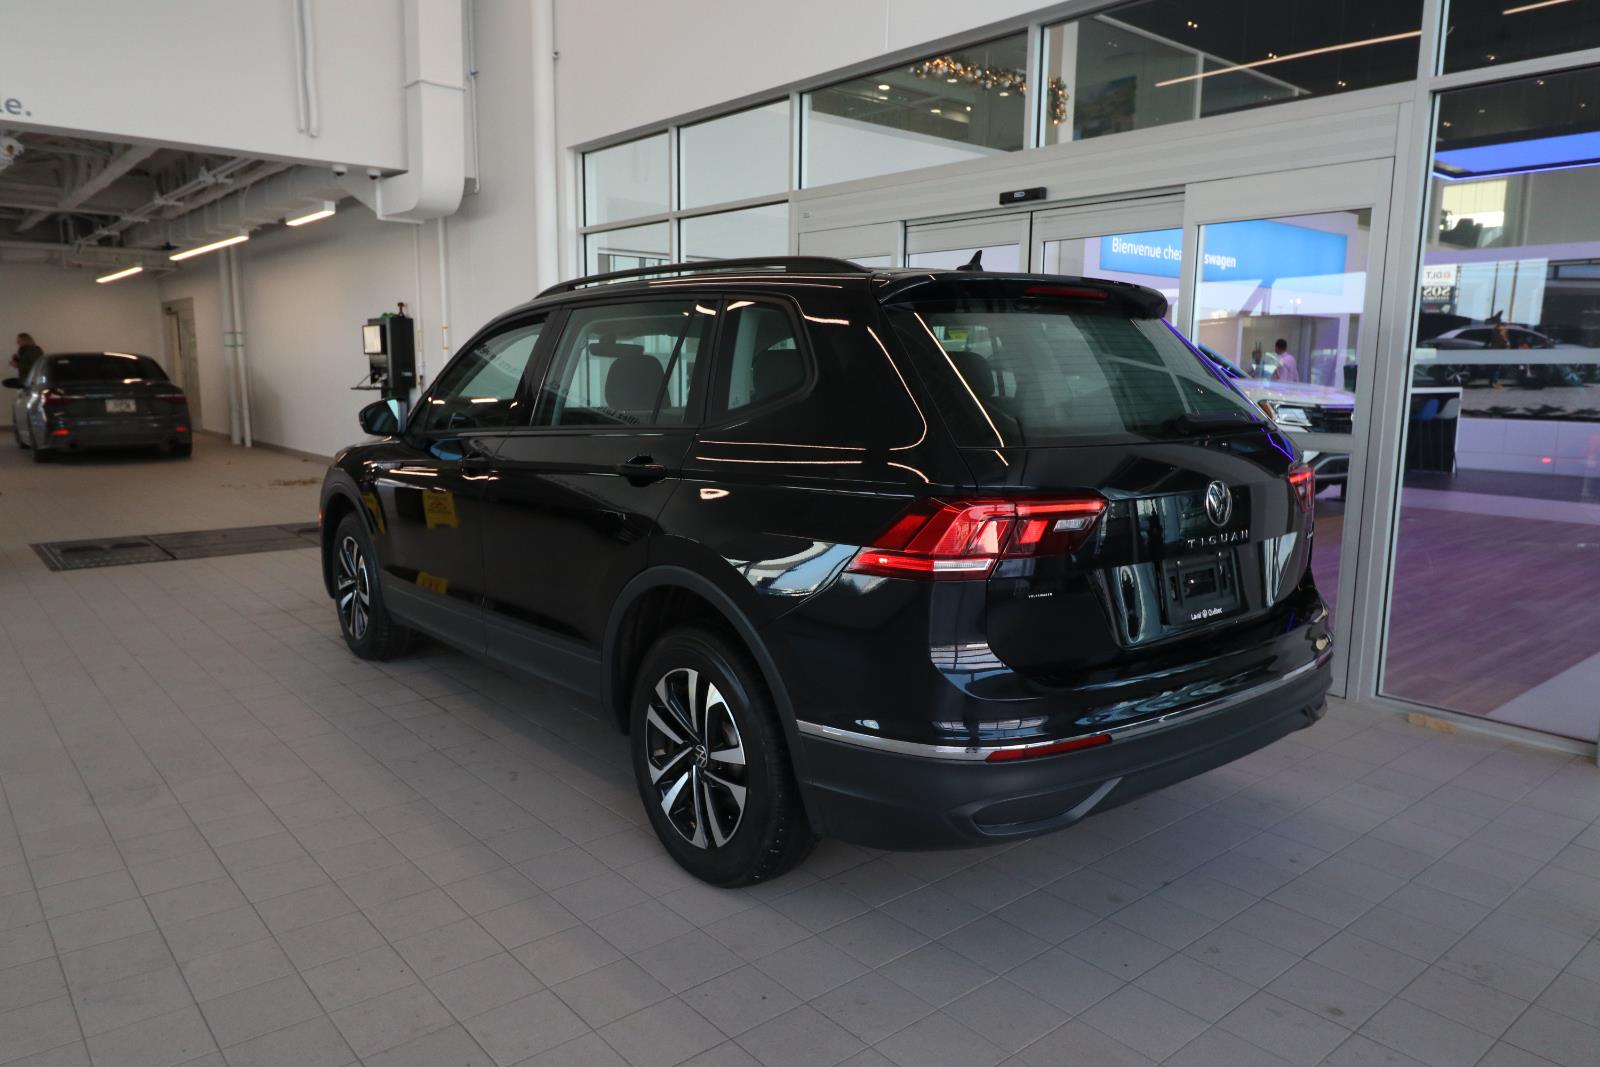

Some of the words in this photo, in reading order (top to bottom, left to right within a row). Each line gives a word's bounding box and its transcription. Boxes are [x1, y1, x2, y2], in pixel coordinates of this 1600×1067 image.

[1112, 237, 1161, 259] Bienvenue
[1204, 254, 1237, 271] swagen
[1187, 529, 1249, 549] TIGUAN
